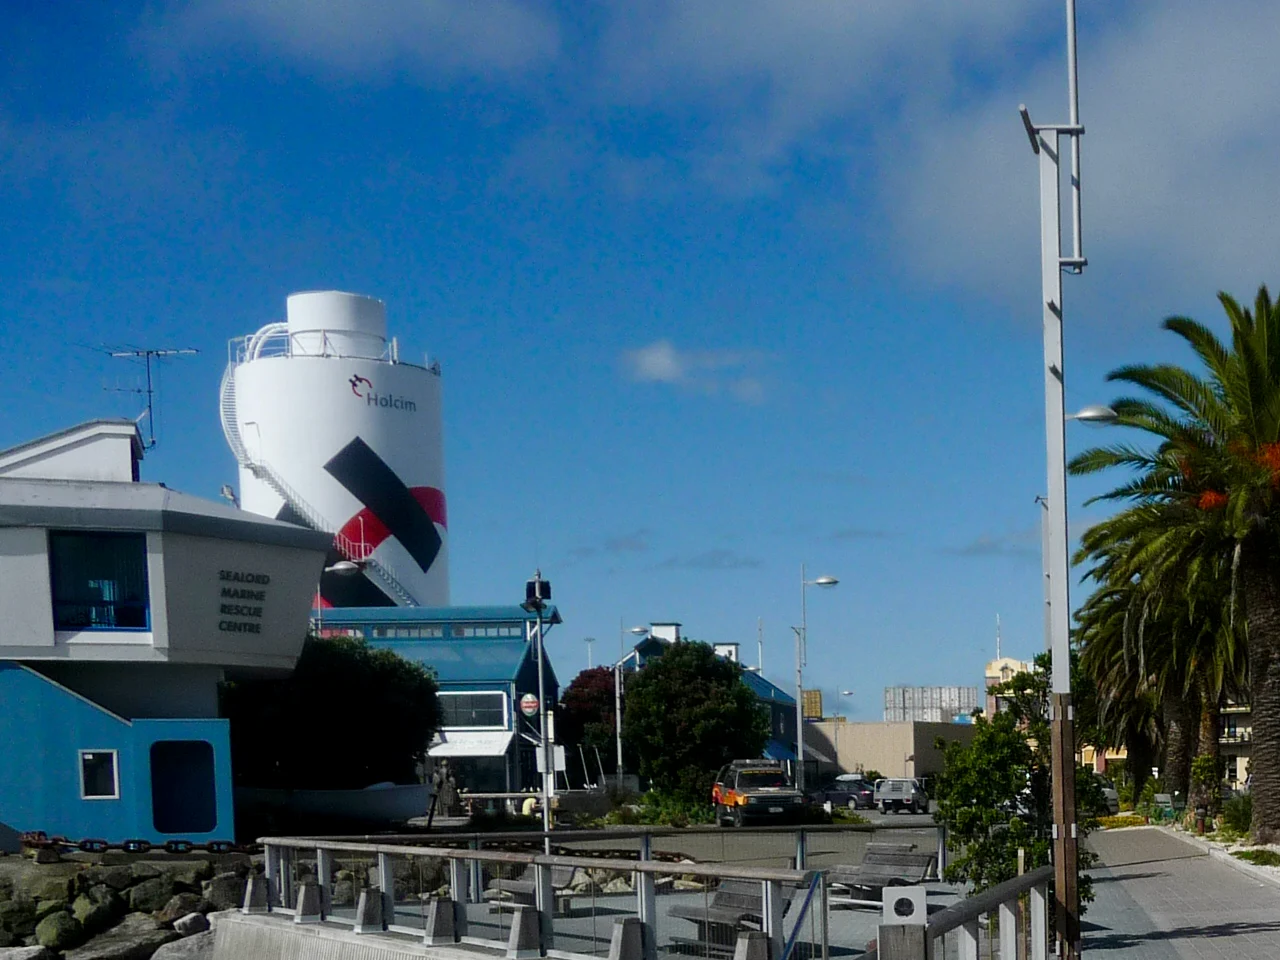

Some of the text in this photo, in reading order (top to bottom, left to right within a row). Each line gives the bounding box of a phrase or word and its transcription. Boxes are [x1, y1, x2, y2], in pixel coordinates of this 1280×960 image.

[367, 392, 417, 412] Holcim
[218, 569, 271, 586] SEALORD
[220, 587, 266, 601] MARINE
[220, 603, 263, 618] RESCUE
[218, 620, 261, 634] CENTRE
